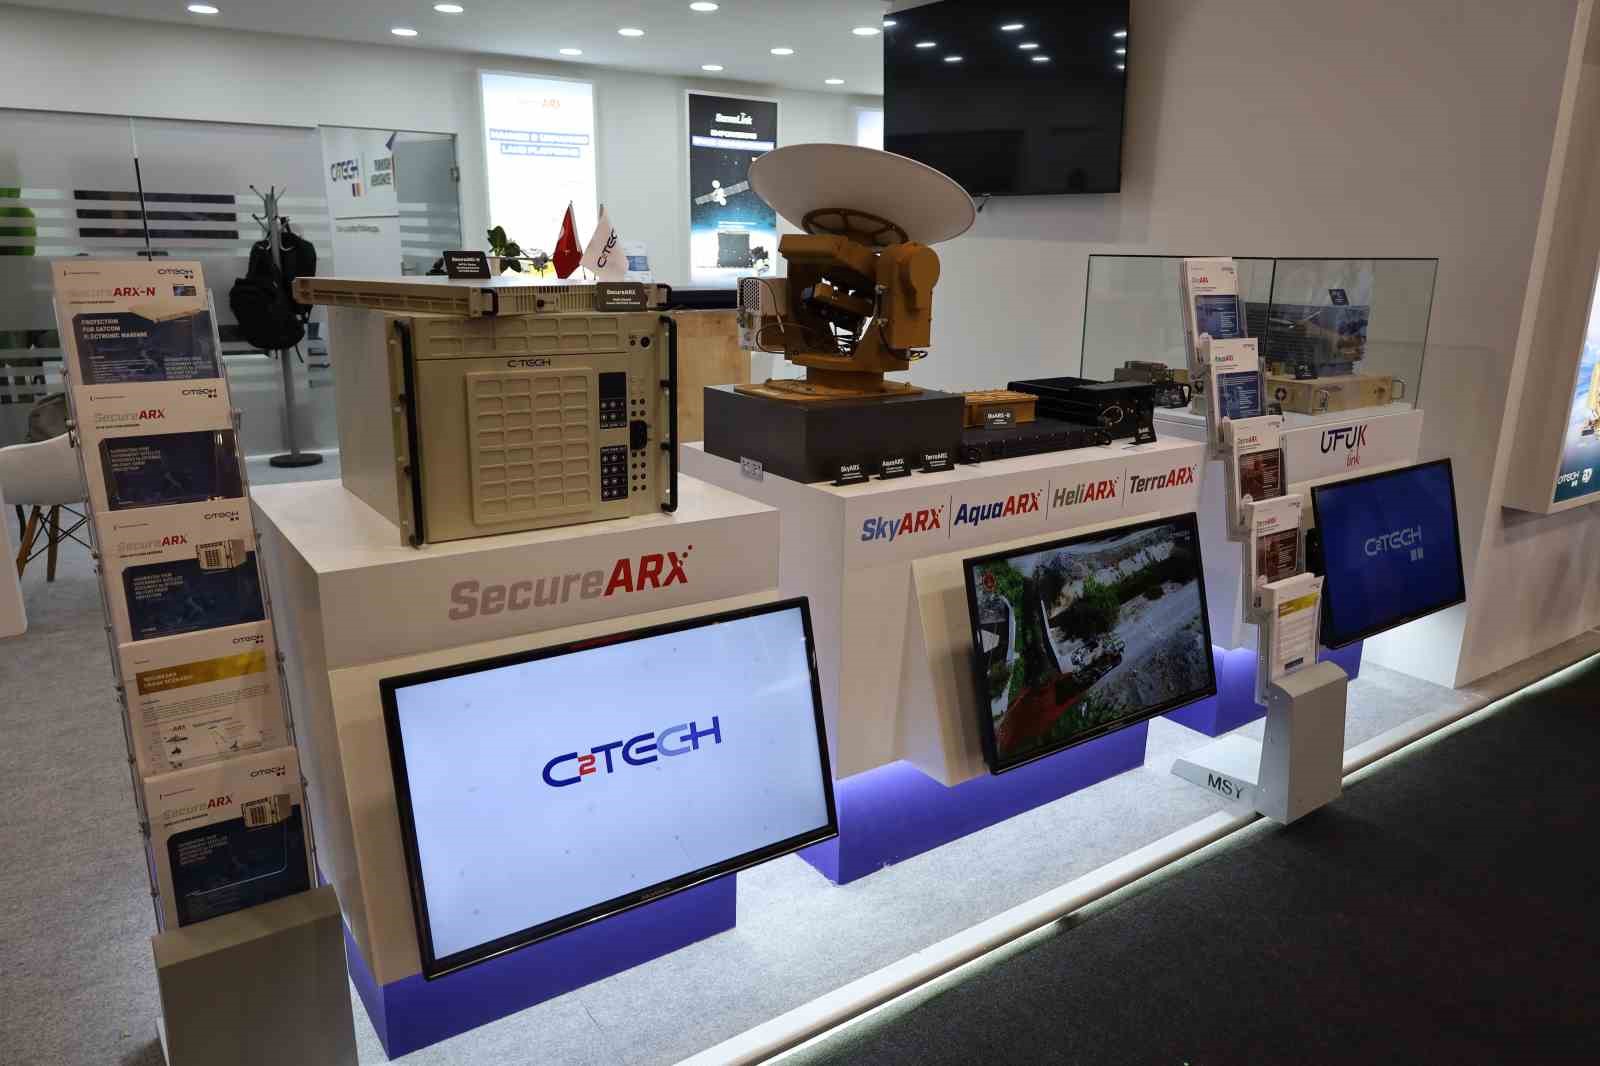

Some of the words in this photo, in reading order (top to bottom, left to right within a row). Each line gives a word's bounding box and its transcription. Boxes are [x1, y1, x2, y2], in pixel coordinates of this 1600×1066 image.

[1320, 424, 1367, 454] UFUK
[1052, 477, 1119, 509] HeliARX
[1129, 465, 1196, 495] TerraARX
[861, 507, 944, 542] SkyARX
[954, 490, 1042, 528] AquaARX
[1364, 525, 1423, 556] C2TECH
[448, 546, 692, 621] SecureARX
[542, 716, 722, 788] C2TECH
[1207, 773, 1245, 799] MSY
